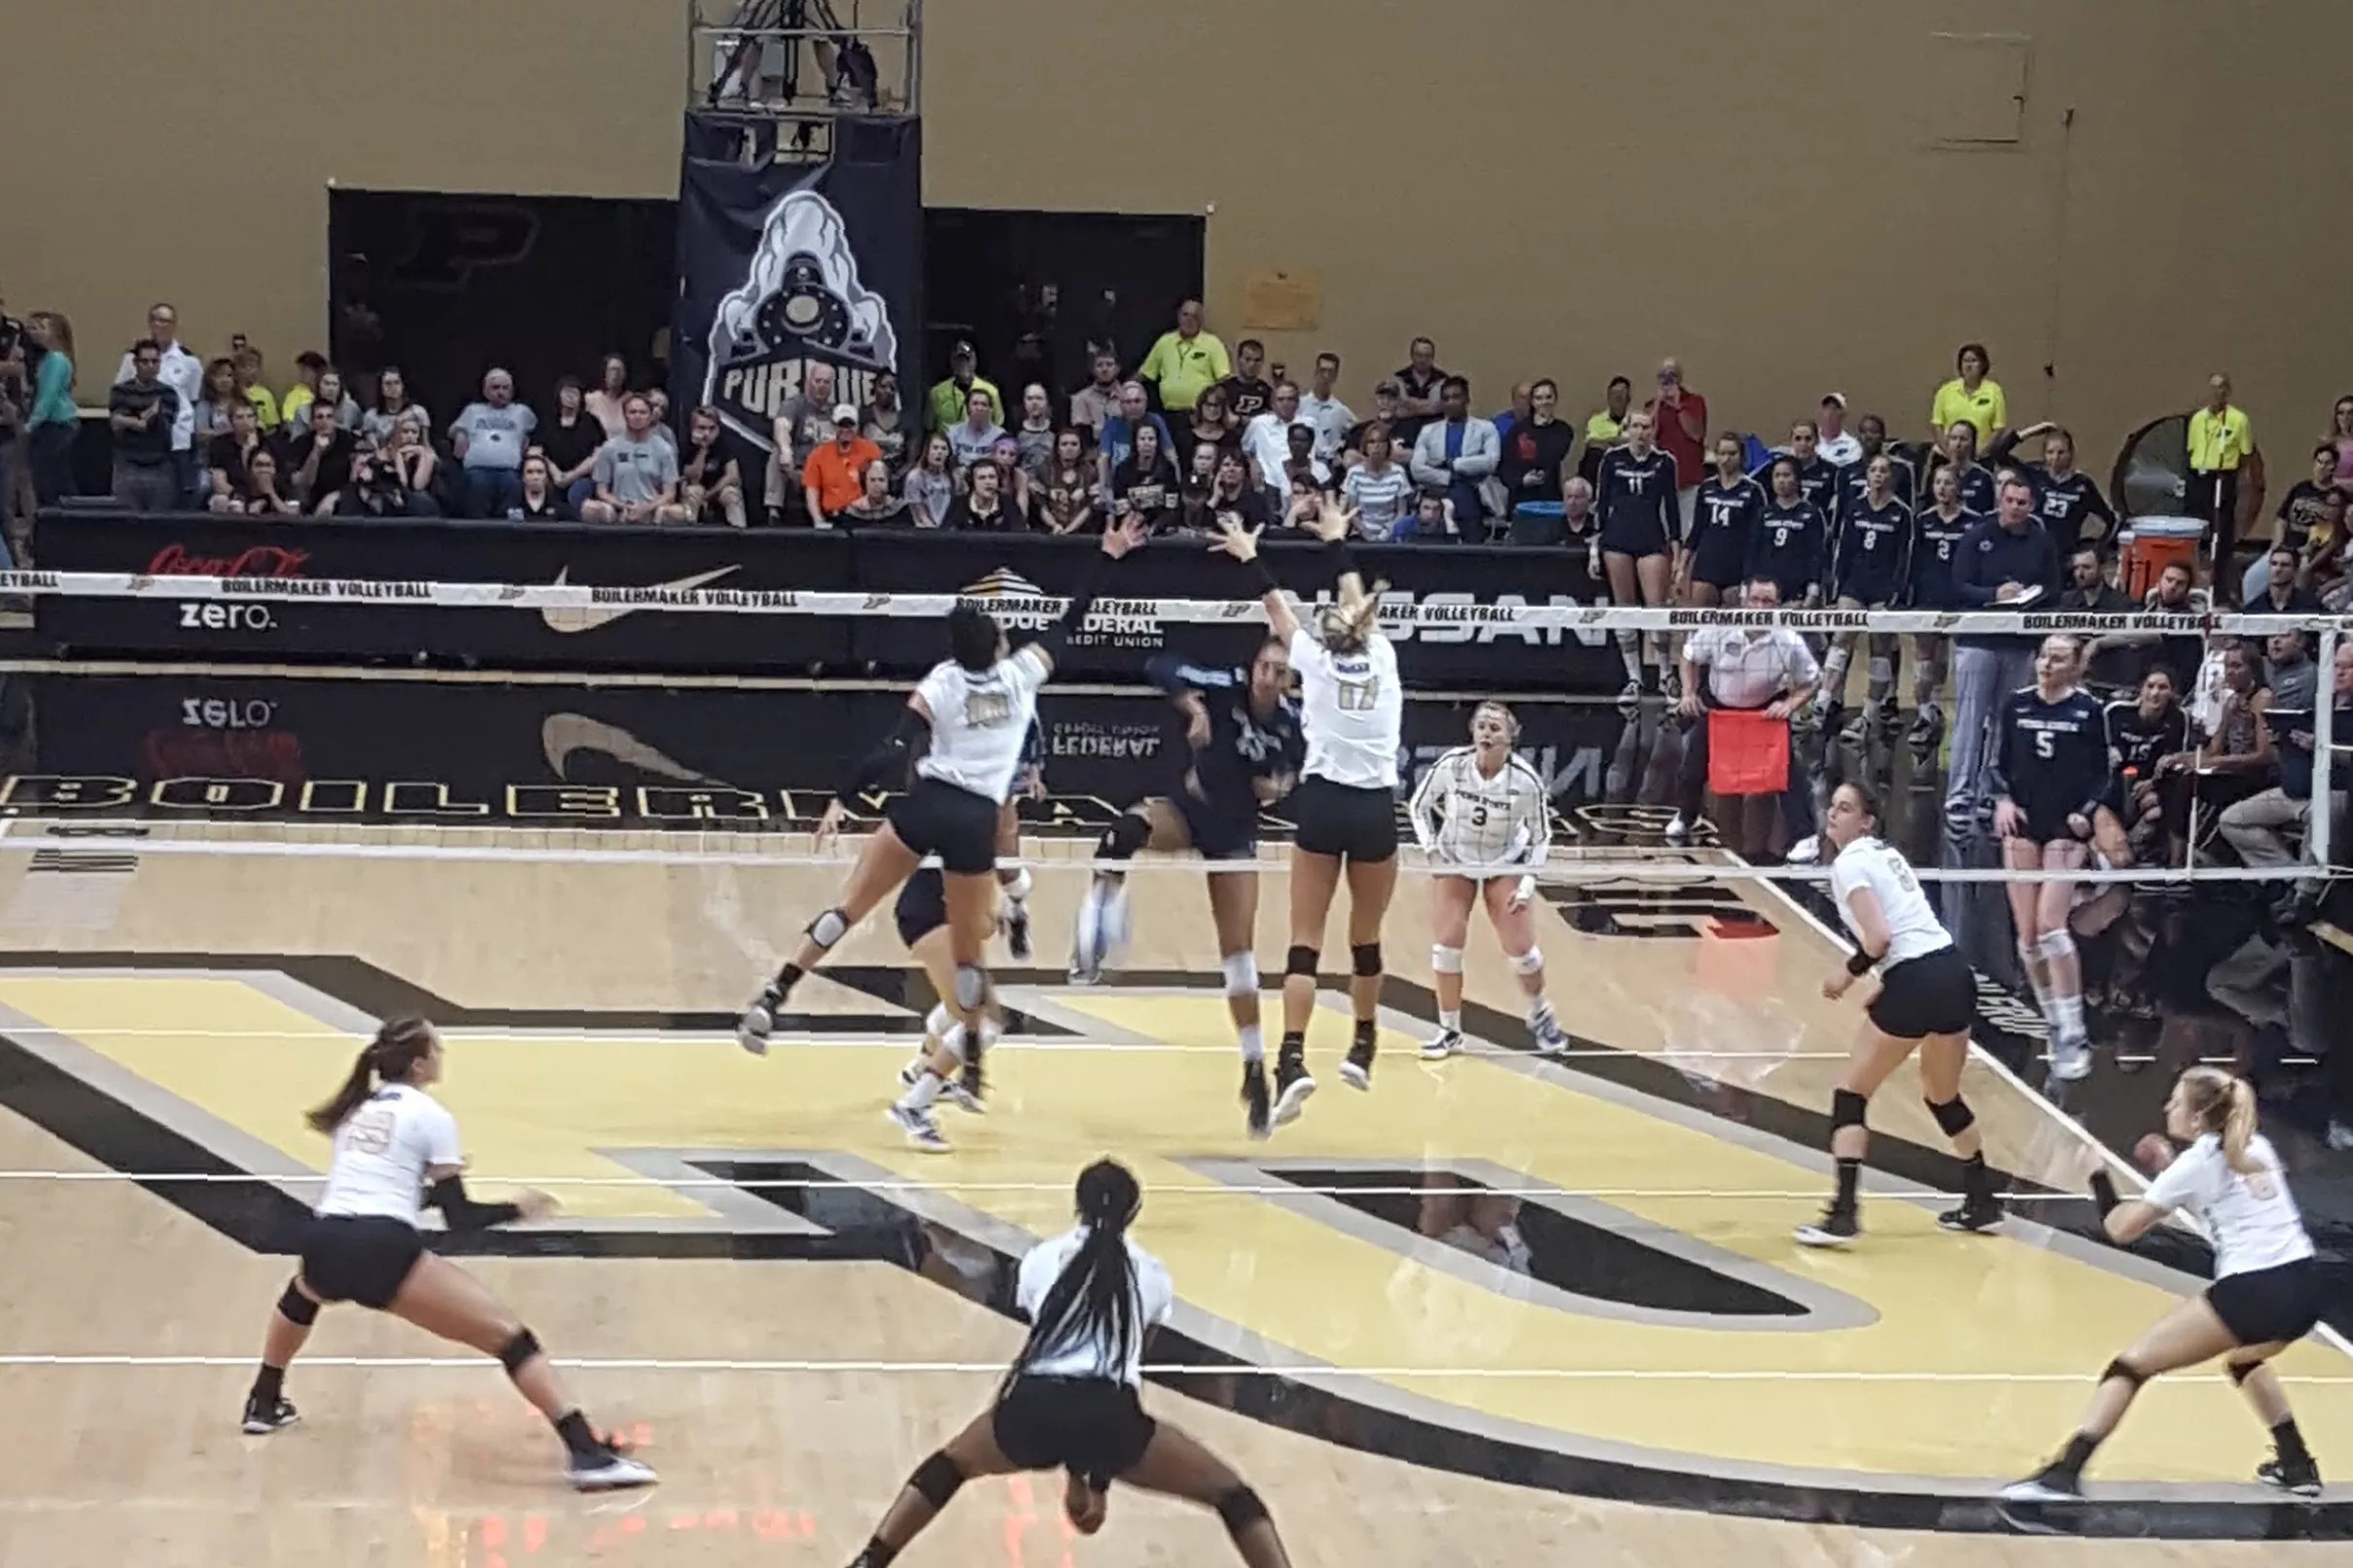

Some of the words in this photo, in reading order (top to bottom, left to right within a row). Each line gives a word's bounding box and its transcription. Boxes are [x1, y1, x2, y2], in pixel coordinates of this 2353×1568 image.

[723, 358, 877, 420] PURUE
[1710, 504, 1730, 527] 14
[2043, 497, 2068, 518] 23
[221, 579, 332, 595] BOILERMAKER
[337, 581, 433, 599] VOLLEYBALL
[591, 588, 700, 606] BOILERMAKER
[706, 591, 798, 608] VOLLEYBALL
[1424, 606, 1516, 623] VOLLEYBALL
[1668, 610, 1774, 626] BOILERMAKER
[1778, 610, 1868, 628] VOLLEYBALL
[2022, 614, 2127, 629] BOILERMAKER
[2132, 614, 2223, 631] VOLLEYBAL
[1081, 617, 1164, 634] DERAL
[1112, 637, 1164, 648] UNION
[2036, 730, 2054, 758] 5
[1471, 805, 1488, 827] 3
